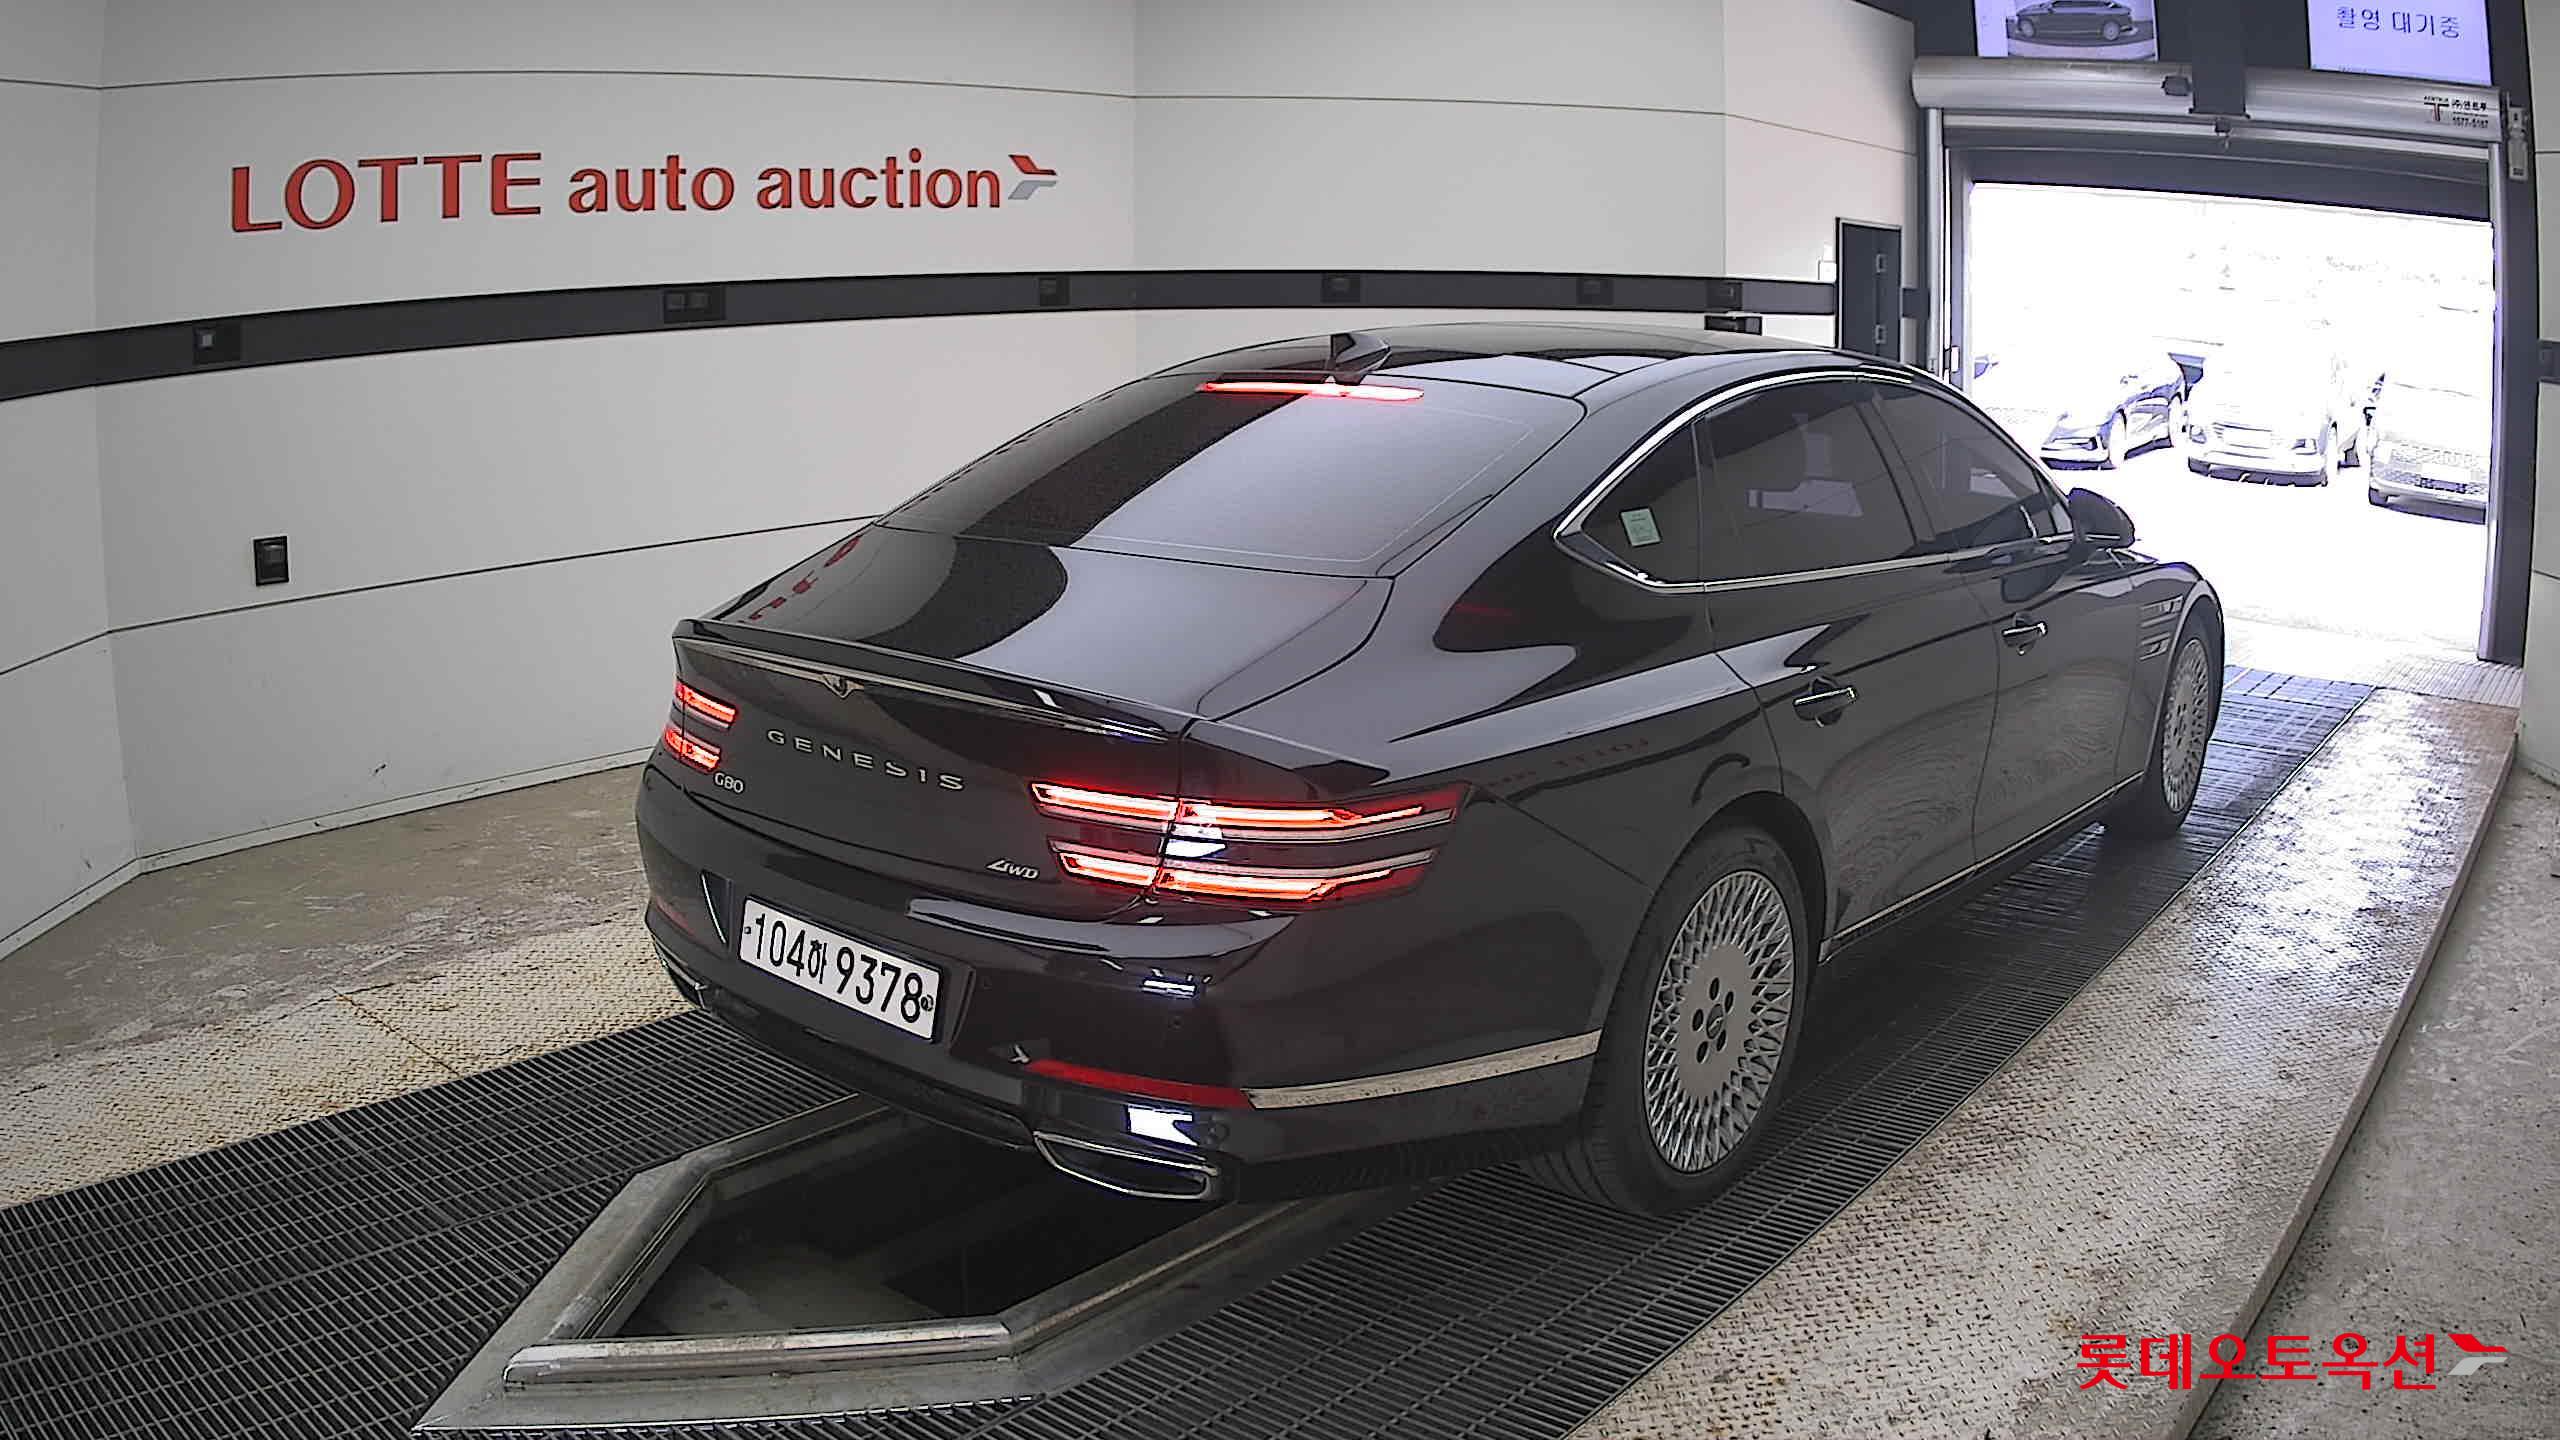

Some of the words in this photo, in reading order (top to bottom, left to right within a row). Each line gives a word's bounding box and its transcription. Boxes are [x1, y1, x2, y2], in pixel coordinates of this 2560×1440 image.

[2337, 5, 2380, 32] 촬영
[2391, 11, 2460, 39] 대기중
[230, 151, 543, 233] LOTTE
[568, 154, 736, 214] auto
[756, 148, 1001, 210] auction
[713, 771, 745, 795] G80
[767, 729, 966, 791] GENESIS
